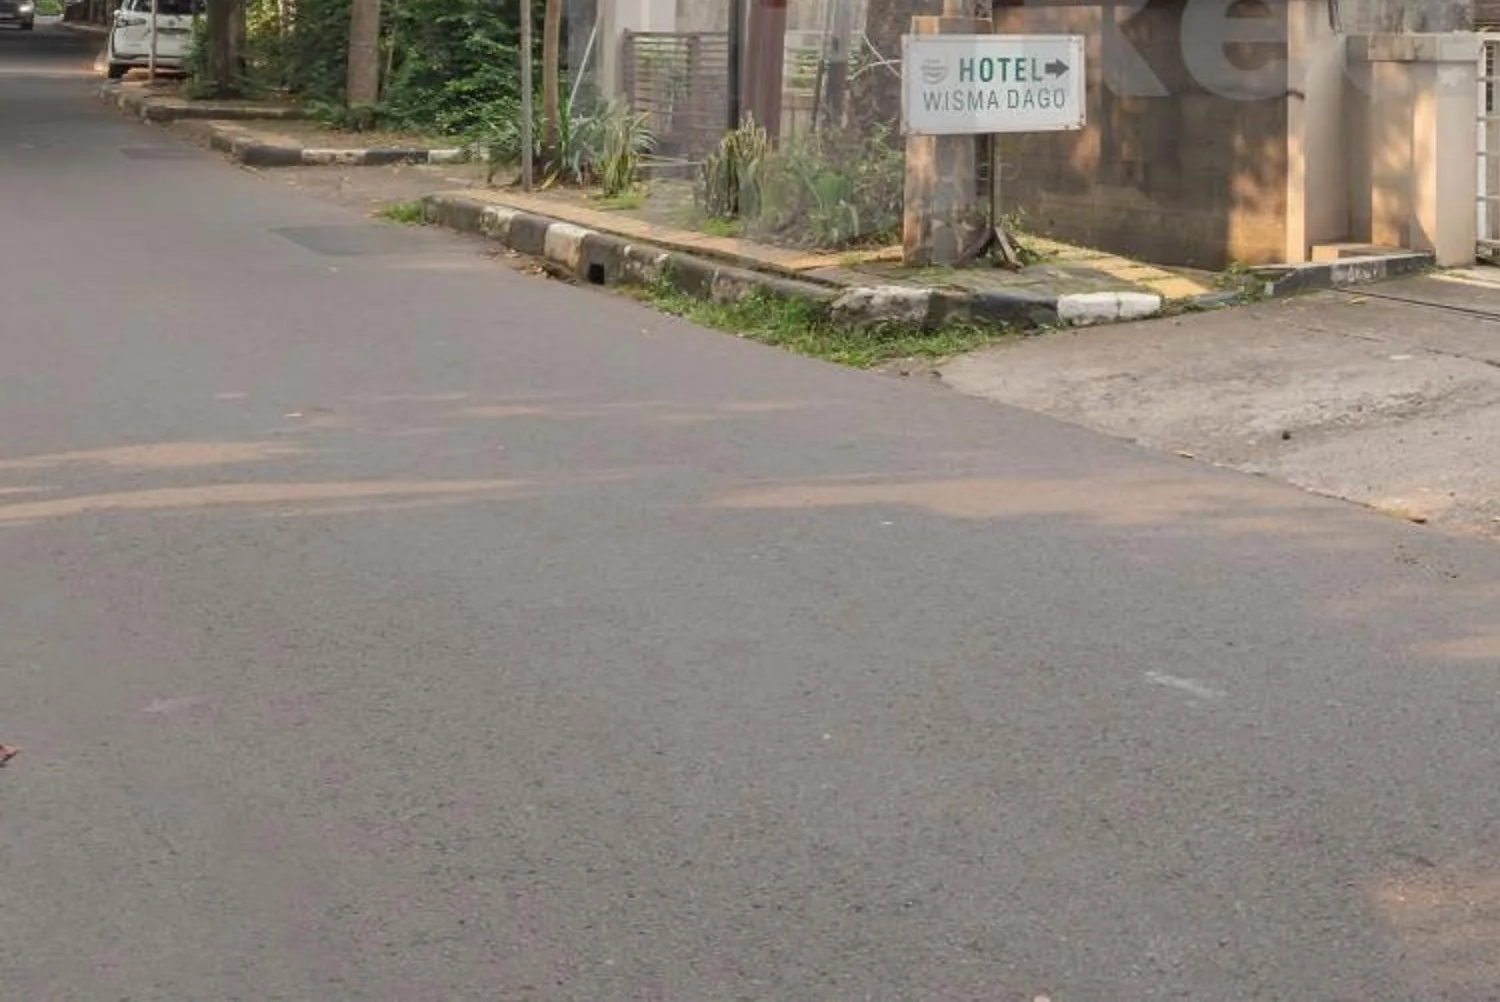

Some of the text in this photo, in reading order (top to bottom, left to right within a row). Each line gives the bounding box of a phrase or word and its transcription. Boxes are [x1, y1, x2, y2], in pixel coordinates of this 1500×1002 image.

[959, 57, 1043, 83] HOTEL
[923, 87, 1065, 112] WISMA DAGO
